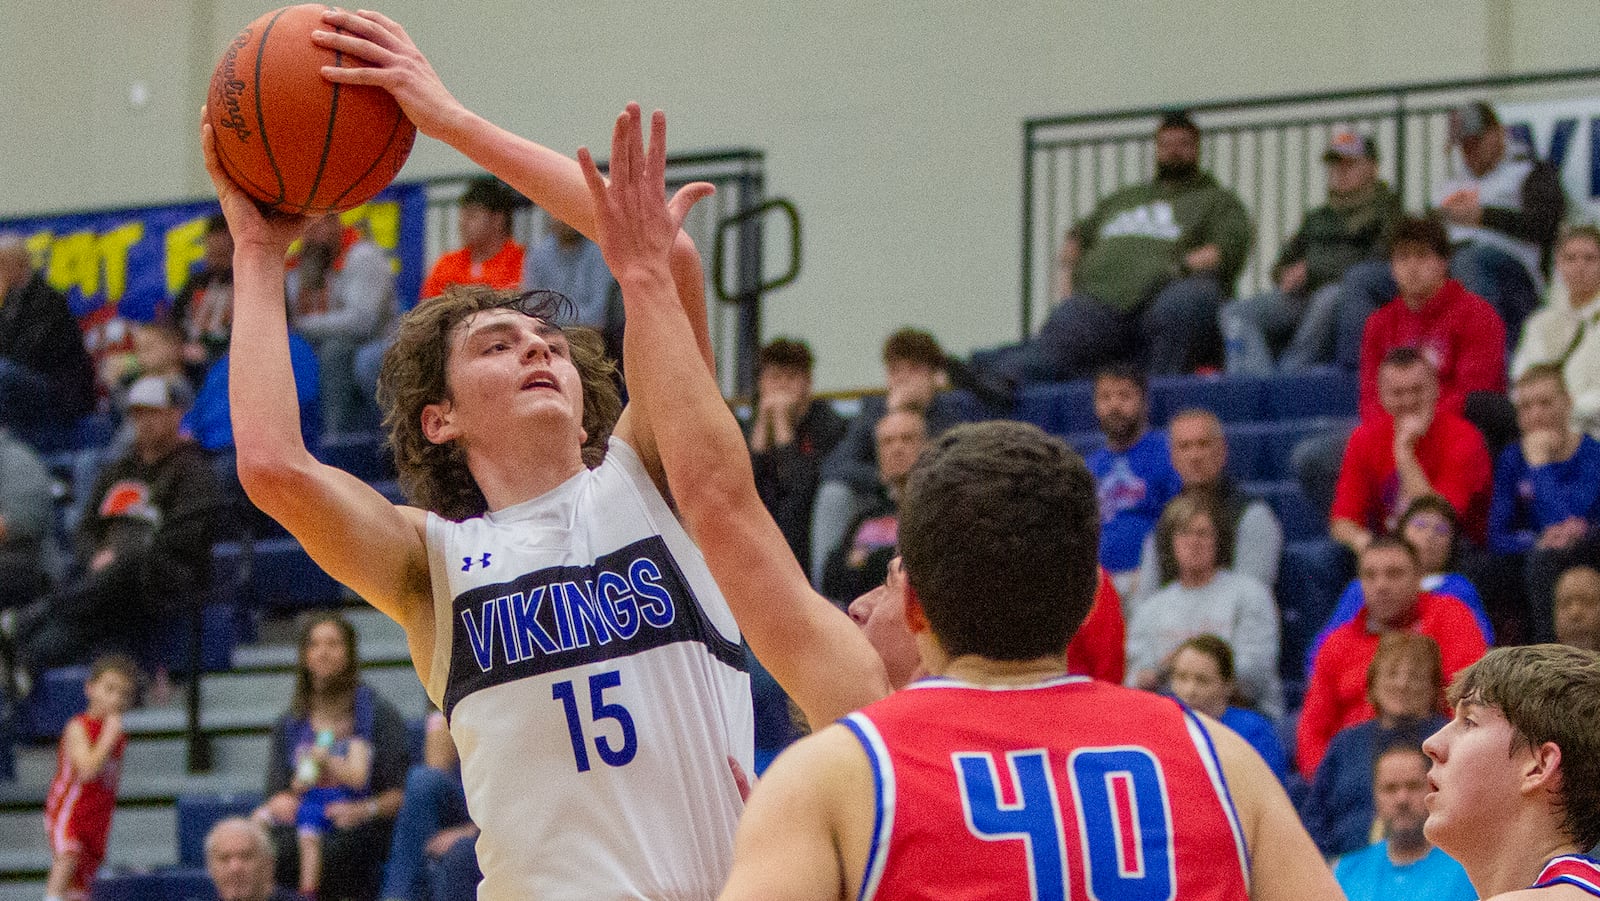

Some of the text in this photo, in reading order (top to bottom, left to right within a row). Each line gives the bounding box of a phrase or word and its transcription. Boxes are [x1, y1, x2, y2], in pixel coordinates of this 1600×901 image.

[221, 28, 252, 144] Rawlings
[461, 557, 676, 672] VIKINGS
[551, 669, 638, 773] 15
[951, 744, 1178, 901] 40
